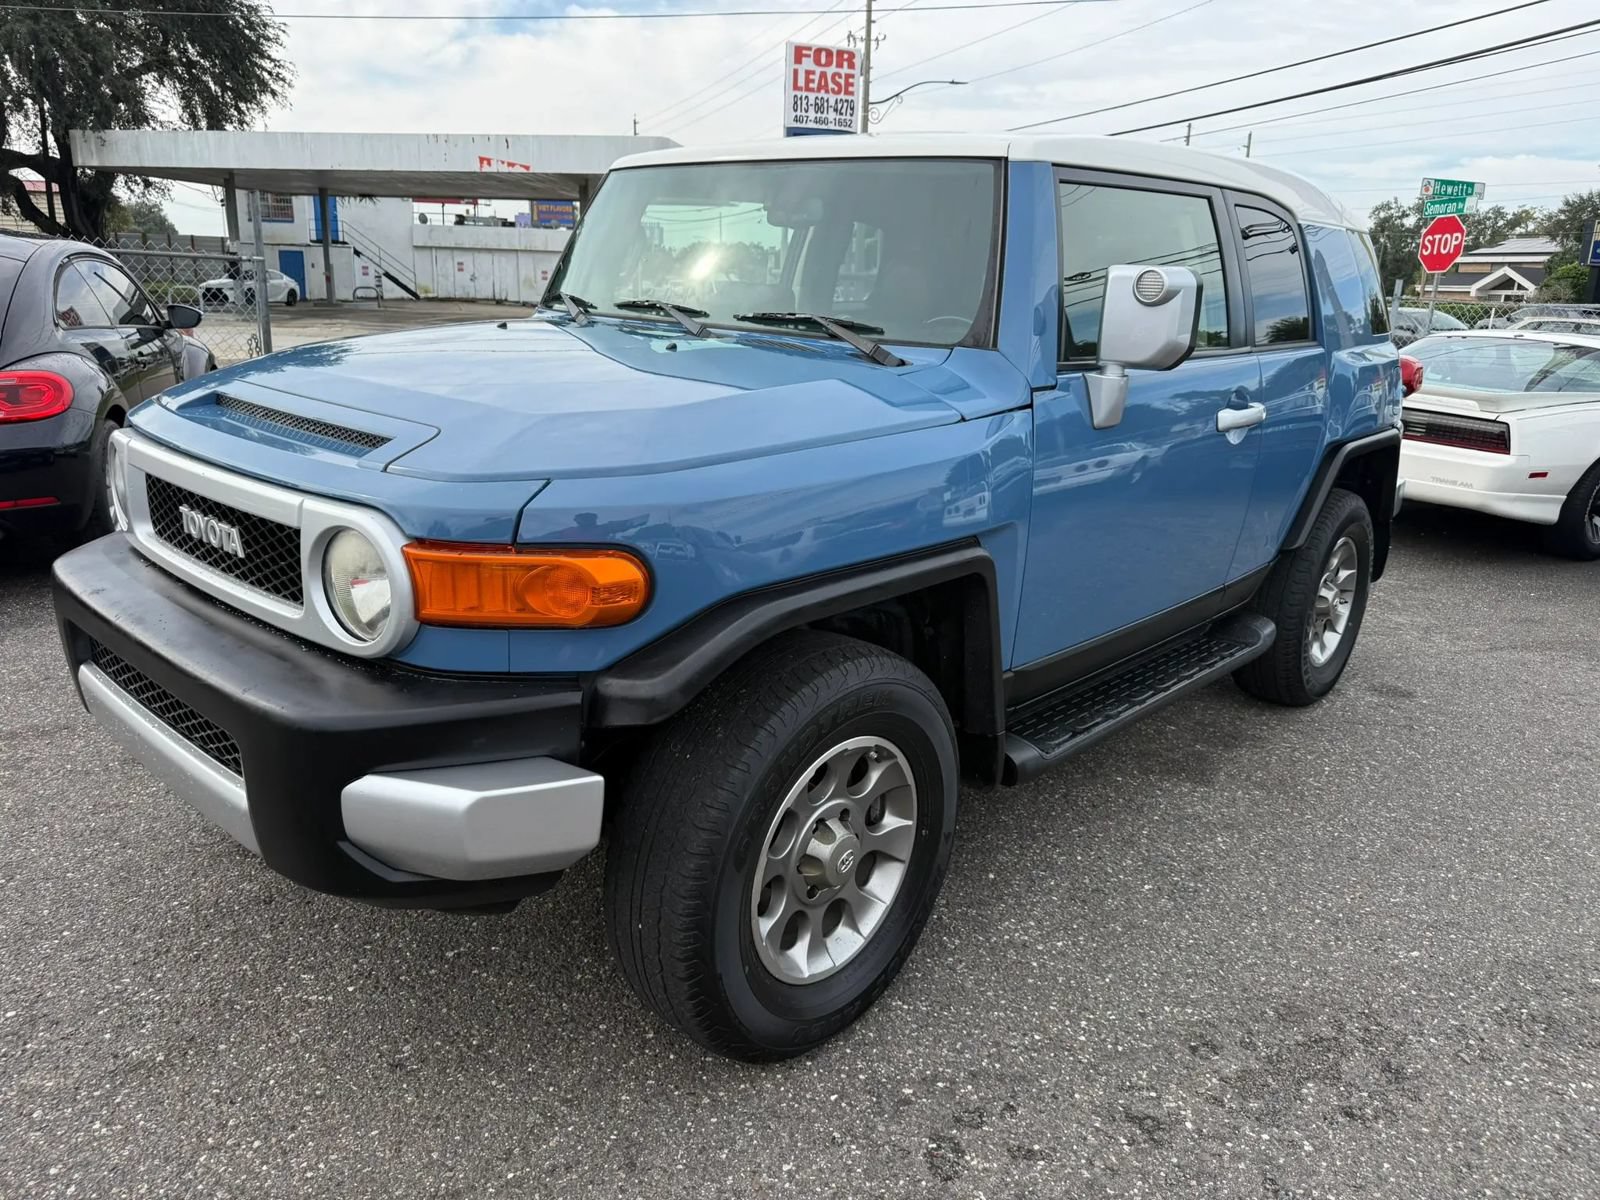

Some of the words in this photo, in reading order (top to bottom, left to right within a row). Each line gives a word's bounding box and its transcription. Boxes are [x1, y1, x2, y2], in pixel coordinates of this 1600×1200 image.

[794, 45, 856, 70] FOR
[792, 68, 855, 96] LEASE
[792, 94, 855, 117] 813-681-4279
[793, 114, 853, 128] 407-460-1652
[1434, 181, 1467, 196] Hewett
[1425, 202, 1457, 215] Semoran
[1422, 232, 1462, 255] STOP
[179, 504, 245, 558] TOYOTA
